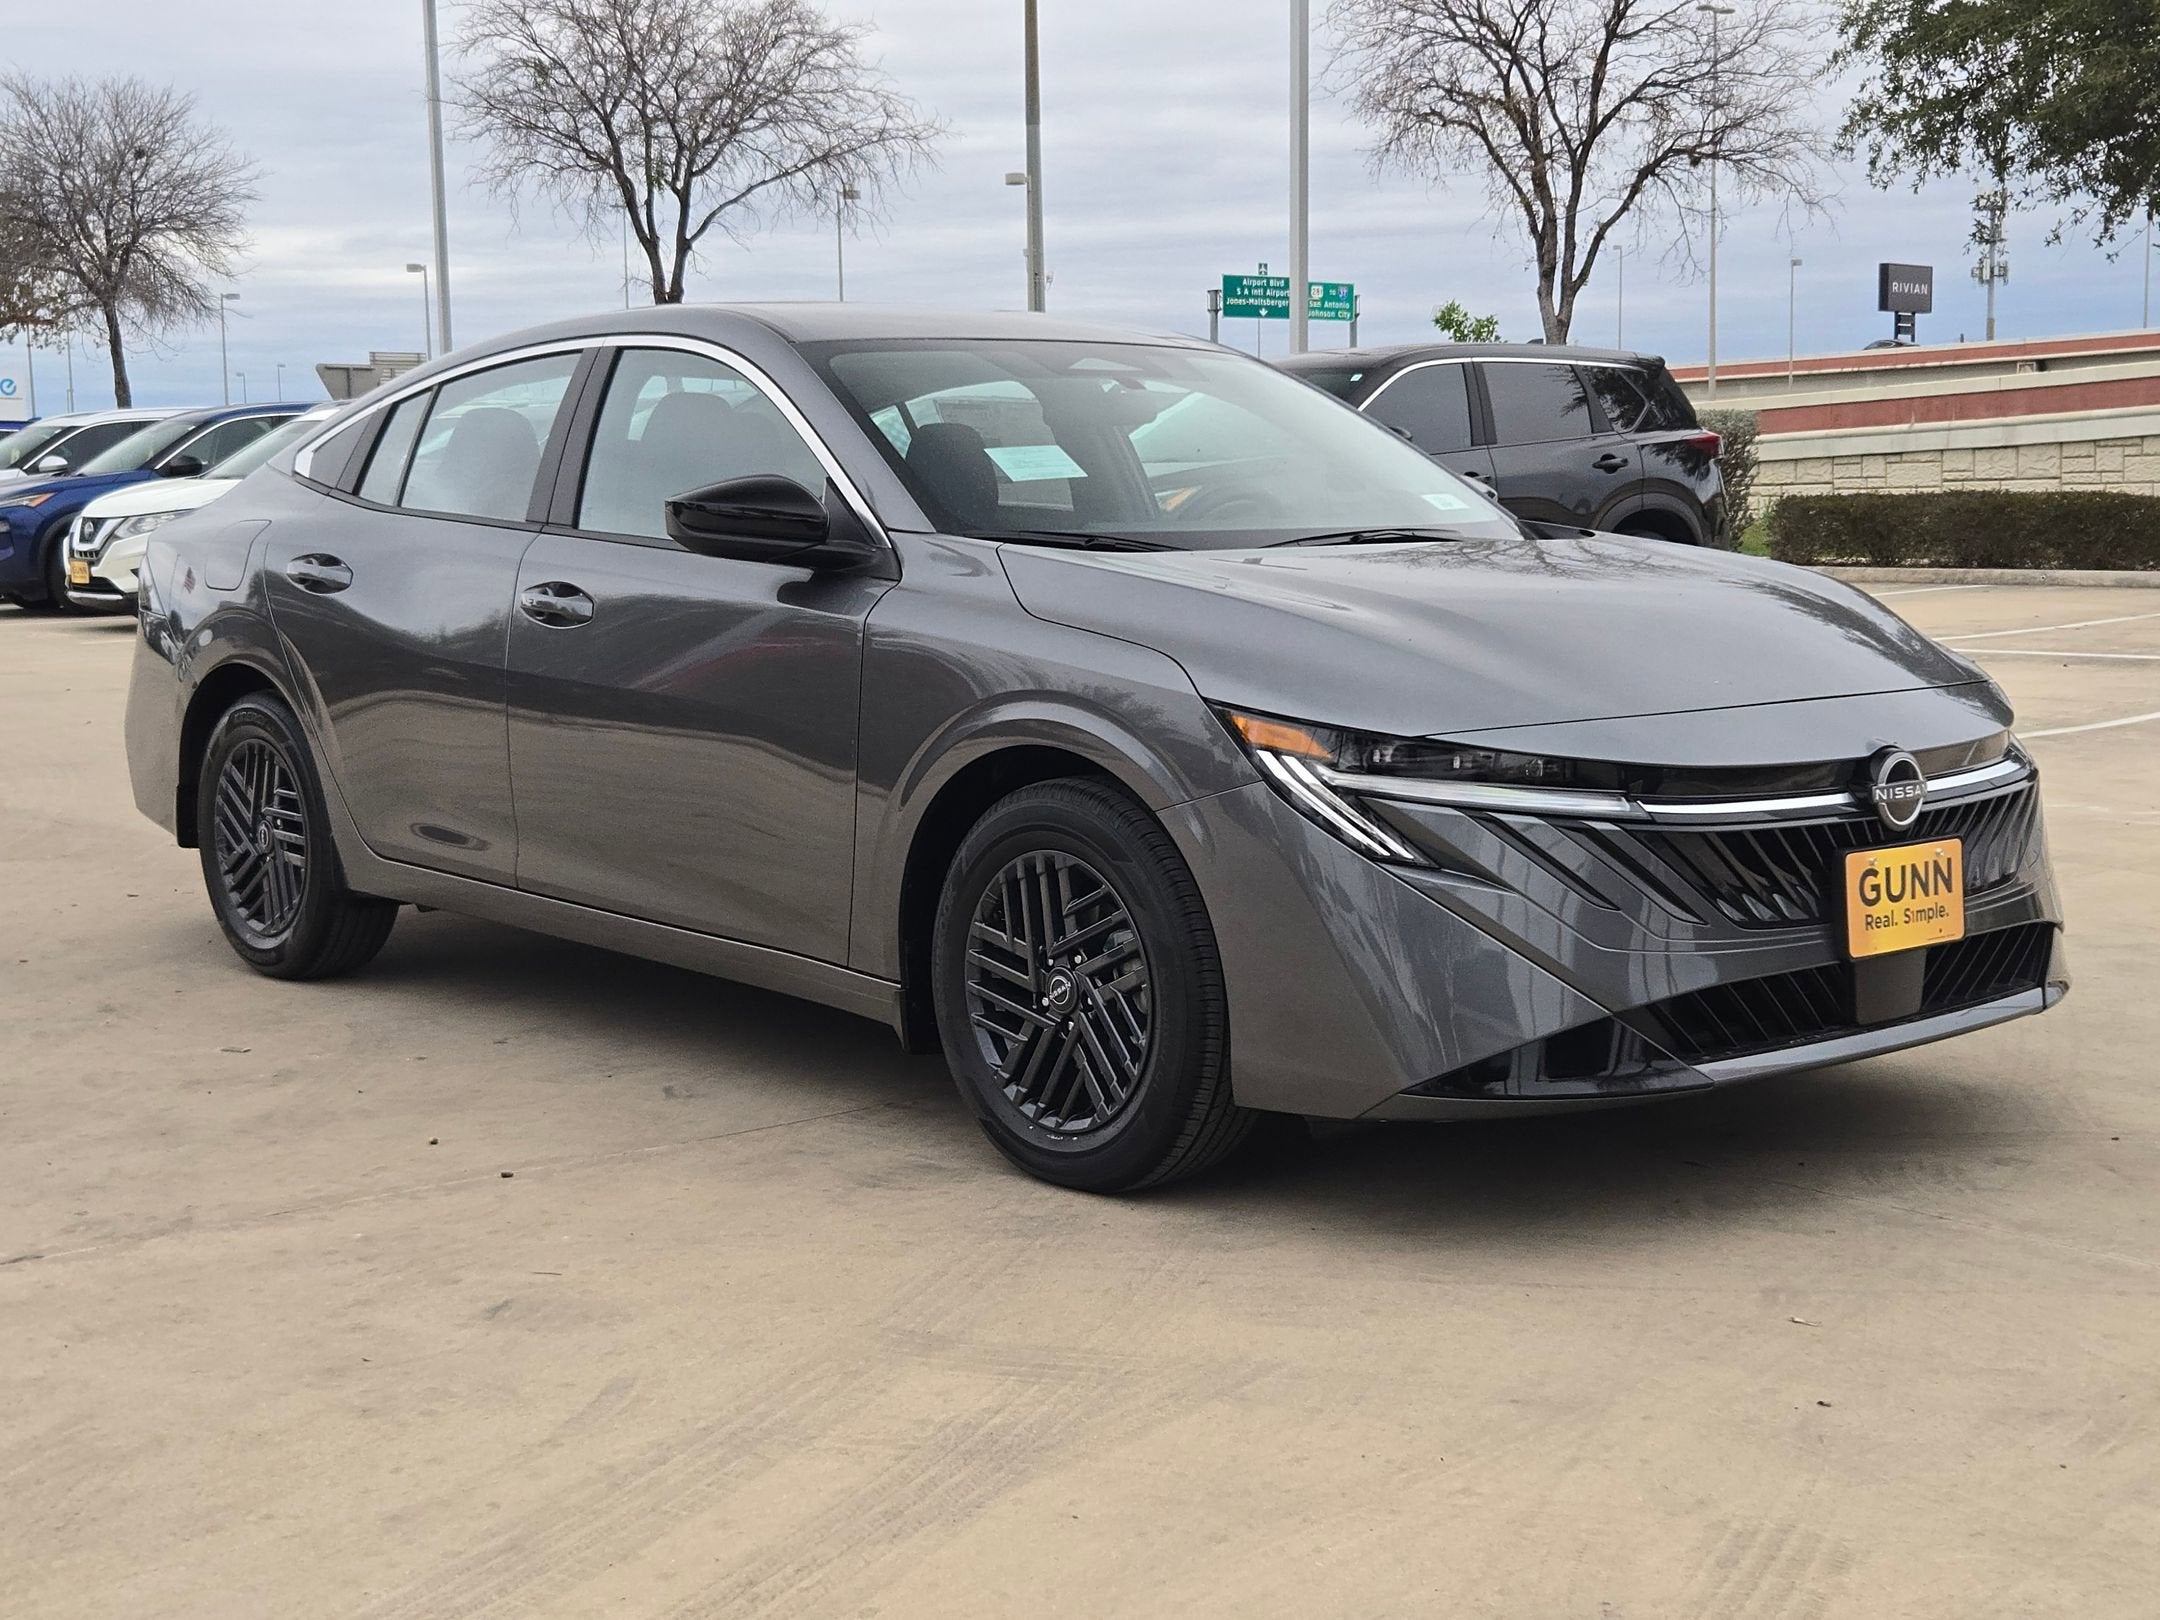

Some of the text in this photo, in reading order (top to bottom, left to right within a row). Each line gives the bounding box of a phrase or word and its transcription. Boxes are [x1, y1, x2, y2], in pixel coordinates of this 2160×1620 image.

[1242, 278, 1285, 287] Airport Blvd
[1892, 281, 1928, 295] RIVIAN
[1309, 300, 1350, 309] San Antonio
[1337, 310, 1351, 320] City
[1875, 782, 1928, 800] NISSAN
[1859, 857, 1953, 907] GUNN
[1865, 901, 1949, 931] Real. Simple.
